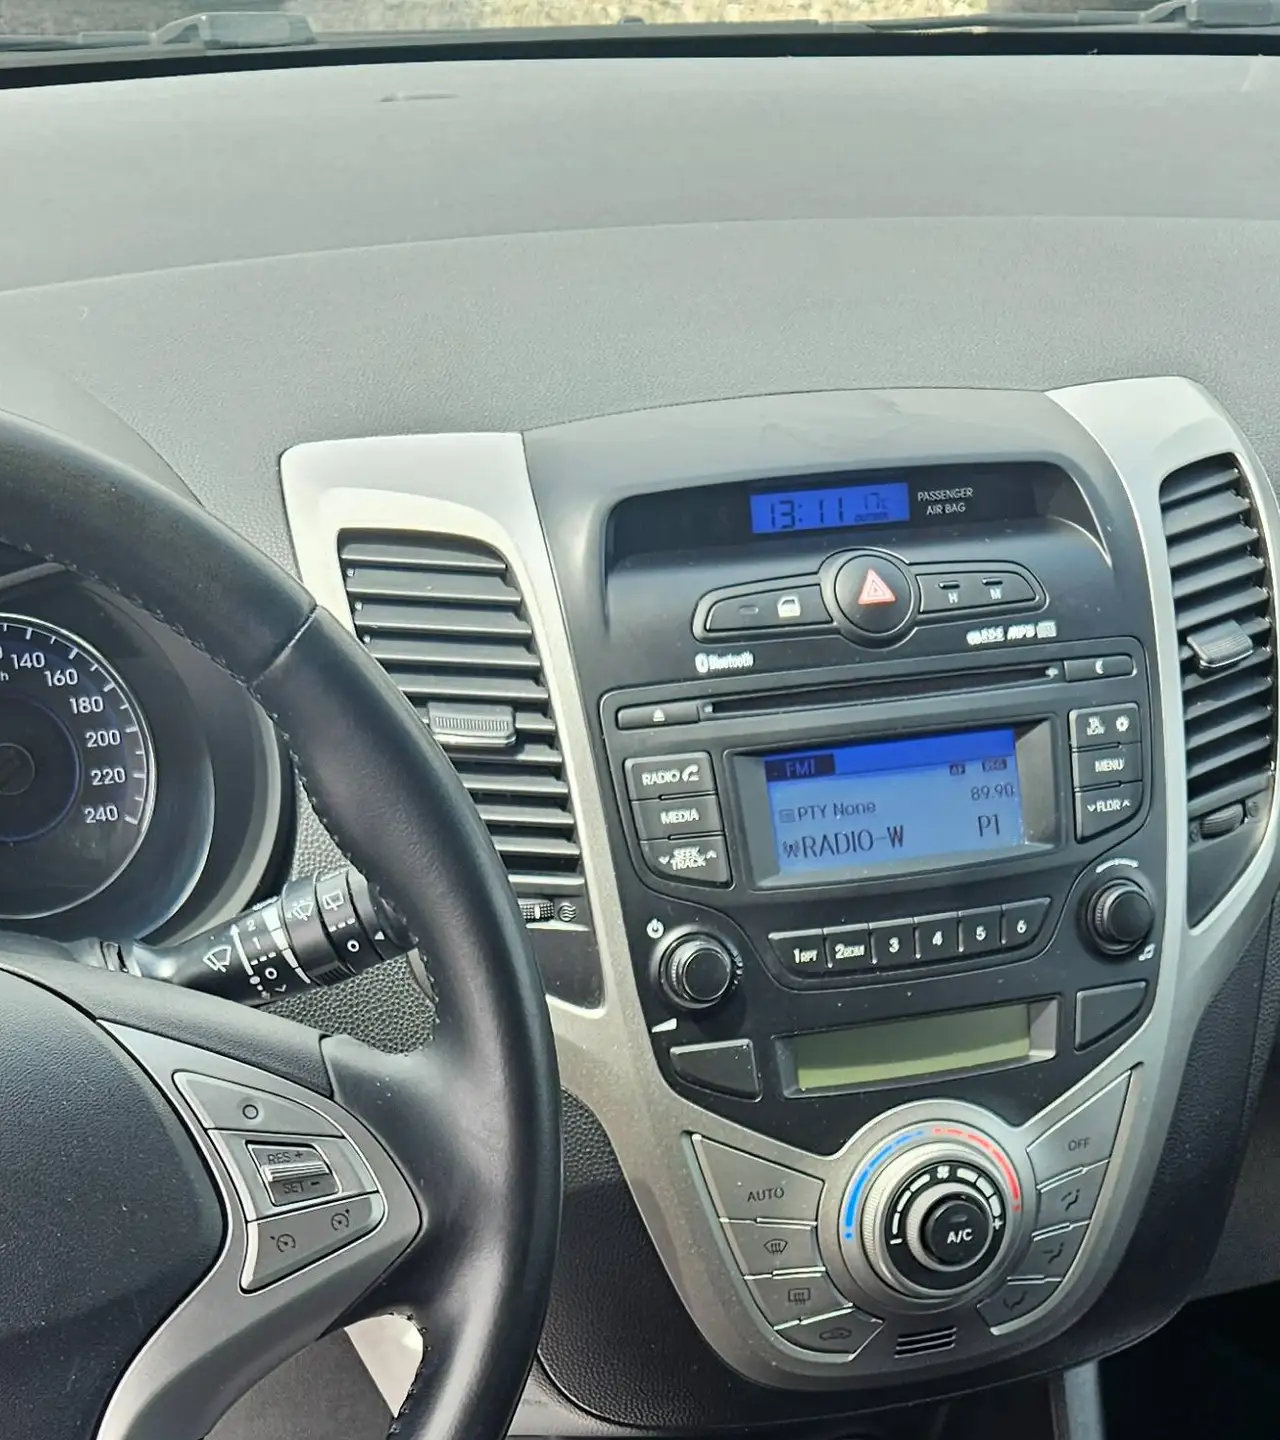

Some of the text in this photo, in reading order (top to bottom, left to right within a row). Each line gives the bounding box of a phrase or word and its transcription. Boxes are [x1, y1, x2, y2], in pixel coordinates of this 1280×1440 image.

[917, 487, 974, 502] PASSENGER
[926, 503, 966, 516] AIR BAG
[11, 651, 45, 670] 140
[44, 669, 78, 687] 160
[69, 696, 104, 714] 180
[85, 729, 121, 748] 200
[1095, 758, 1125, 772] MENU
[91, 767, 126, 786] 220
[641, 768, 680, 786] RADIO
[970, 783, 1015, 801] 89.90
[797, 800, 876, 822] PTY None
[1096, 799, 1121, 812] FLDR
[84, 805, 119, 824] 240
[660, 808, 700, 824] MEDIA
[801, 814, 1001, 859] RADIO-W P1
[673, 846, 701, 858] SEEK
[670, 855, 707, 871] TRACK
[975, 926, 987, 941] 5
[1016, 920, 1028, 934] 6
[889, 937, 900, 953] 3
[932, 931, 943, 946] 4
[1067, 1137, 1091, 1152] OFF
[267, 1151, 291, 1164] RES
[284, 1181, 305, 1194] SET
[747, 1186, 786, 1203] AUTO
[946, 1228, 974, 1246] A/C
